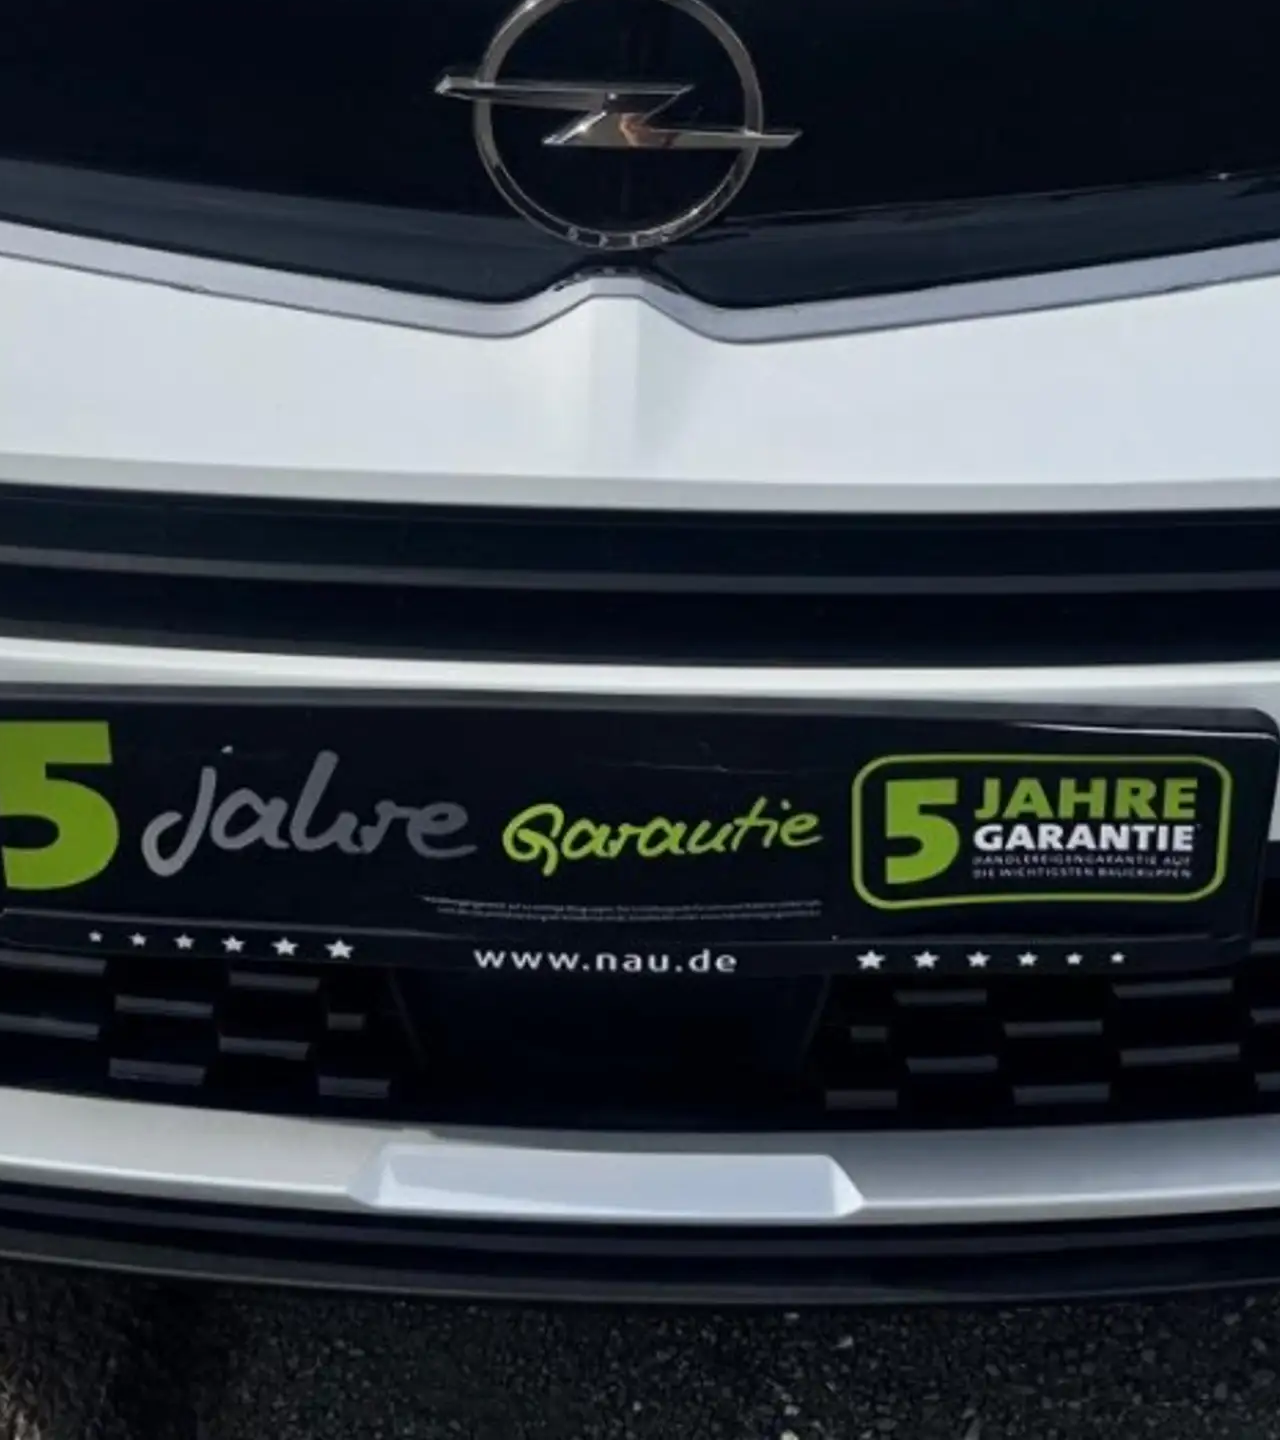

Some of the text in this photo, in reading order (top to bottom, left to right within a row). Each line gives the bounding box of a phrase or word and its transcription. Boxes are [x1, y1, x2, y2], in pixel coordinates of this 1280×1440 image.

[885, 777, 1198, 885] 5 JAHRE
[972, 823, 1195, 852] GARANTIE
[474, 948, 738, 974] www.nau.de
